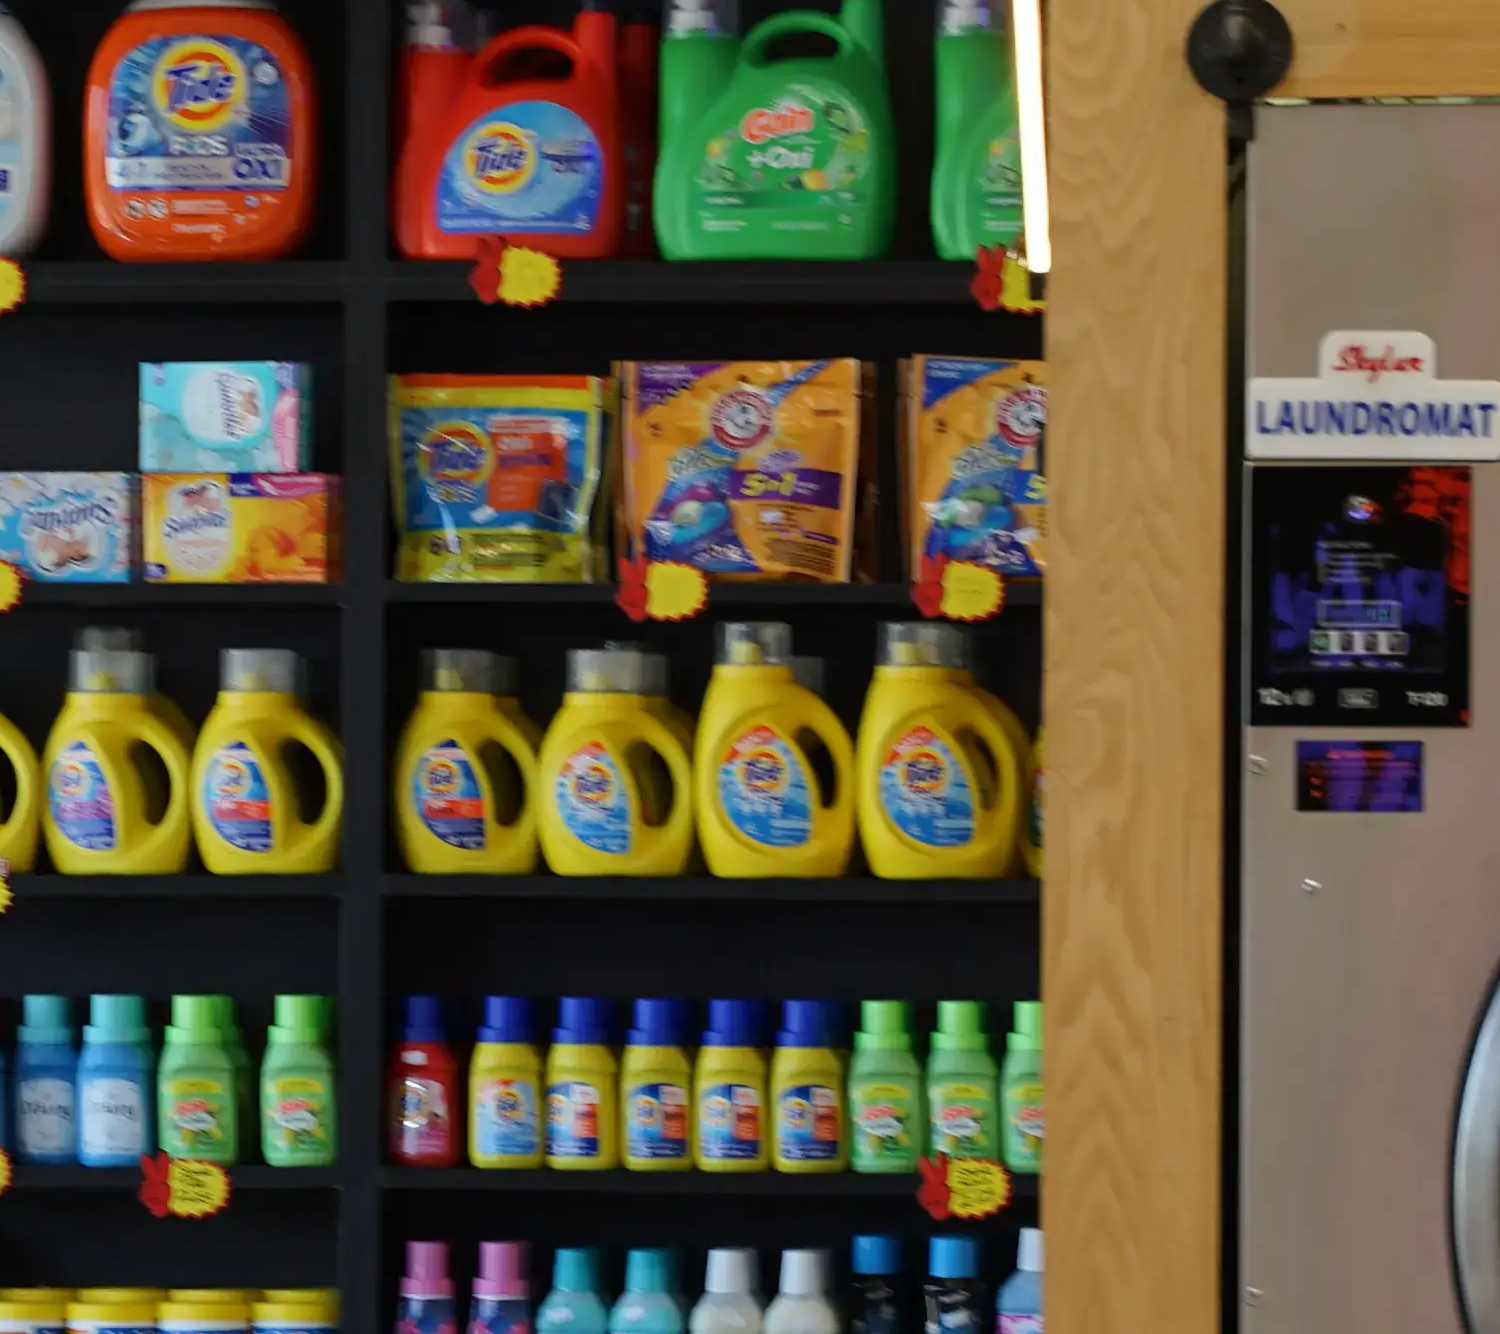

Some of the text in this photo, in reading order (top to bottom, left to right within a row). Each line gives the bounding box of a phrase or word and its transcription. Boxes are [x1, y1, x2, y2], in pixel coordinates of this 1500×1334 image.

[164, 62, 238, 114] Tide
[473, 136, 529, 179] Tide
[1256, 400, 1498, 438] LAUNDROMAT
